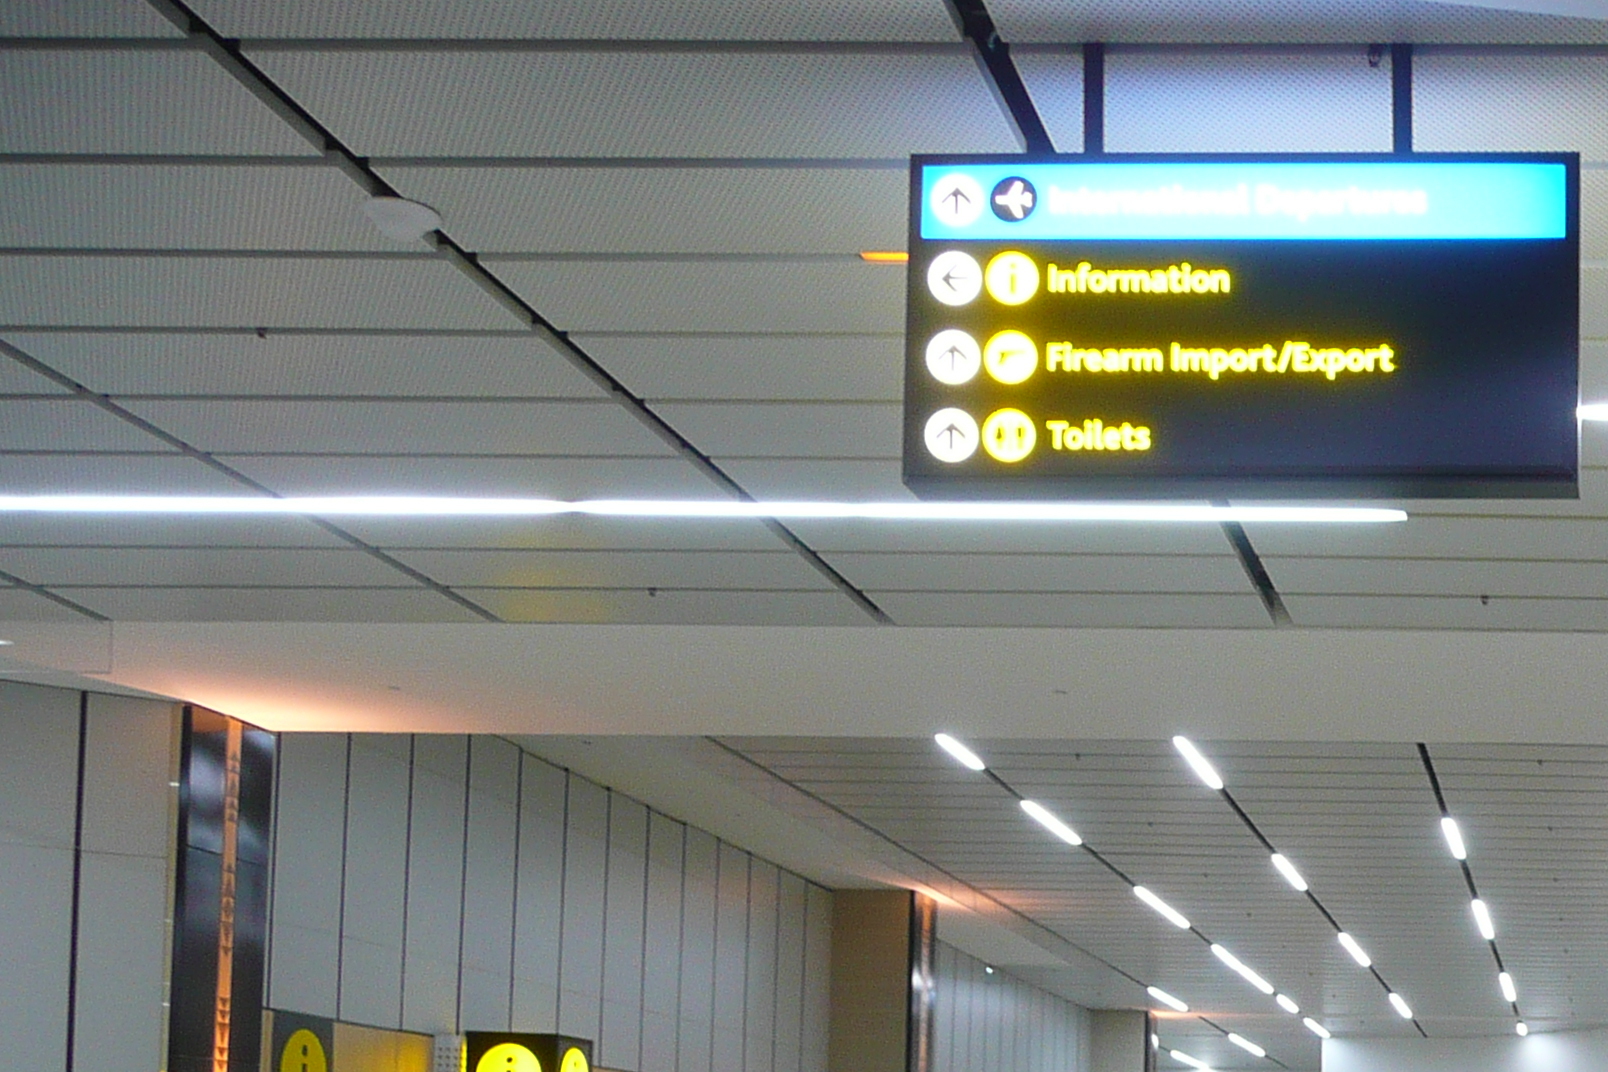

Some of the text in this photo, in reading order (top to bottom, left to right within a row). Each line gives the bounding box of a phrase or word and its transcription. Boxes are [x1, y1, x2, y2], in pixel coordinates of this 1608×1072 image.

[1048, 183, 1428, 223] International Departures
[1046, 261, 1231, 294] Information
[1046, 341, 1395, 381] Firearm Import/Export
[1046, 418, 1152, 450] Toilets
